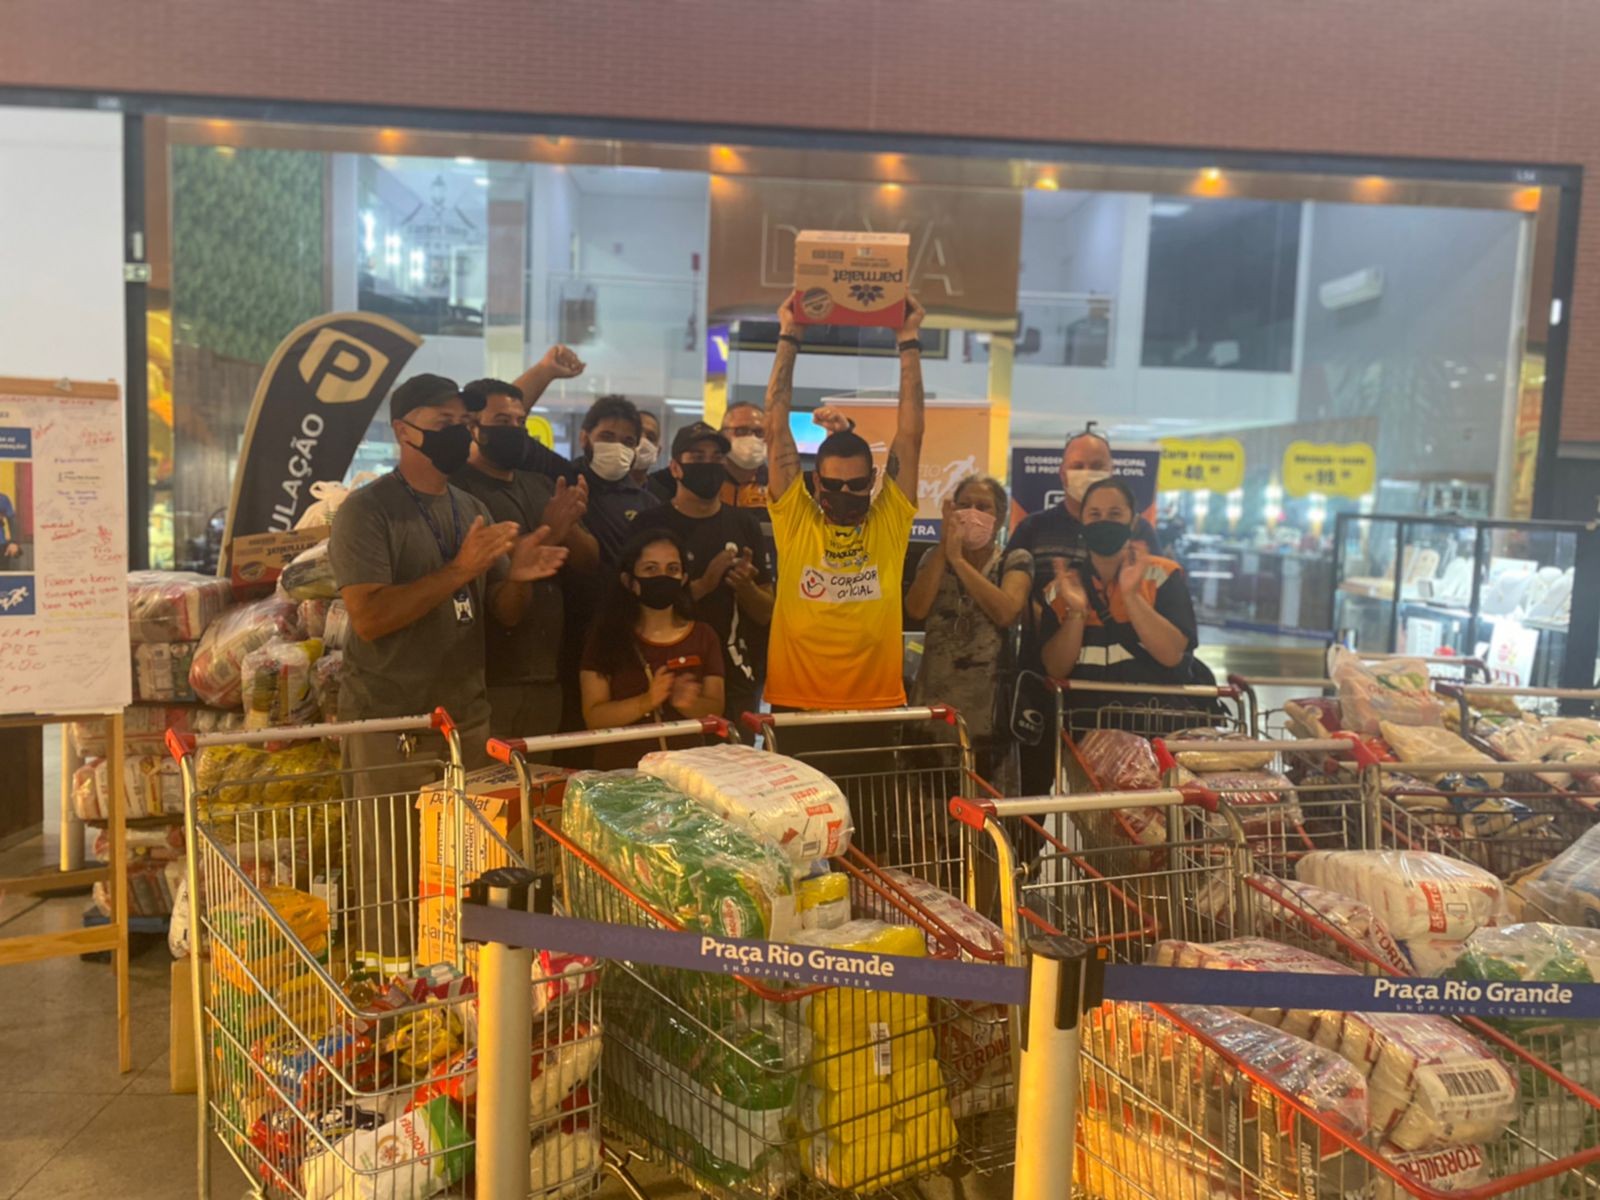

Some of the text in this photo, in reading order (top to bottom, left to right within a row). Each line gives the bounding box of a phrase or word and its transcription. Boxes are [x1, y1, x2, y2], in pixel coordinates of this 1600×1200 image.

[832, 269, 903, 284] parmalat
[1025, 465, 1039, 474] DE
[1123, 468, 1145, 477] CIVIL
[430, 791, 489, 811] parlat
[701, 937, 763, 966] Praça
[768, 944, 803, 967] Rio
[808, 950, 894, 977] Grande
[723, 964, 870, 988] SHOPPING CENTER
[1374, 979, 1573, 1004] Praça Rio Grande
[1396, 1003, 1548, 1015] SHOPPING CENTER
